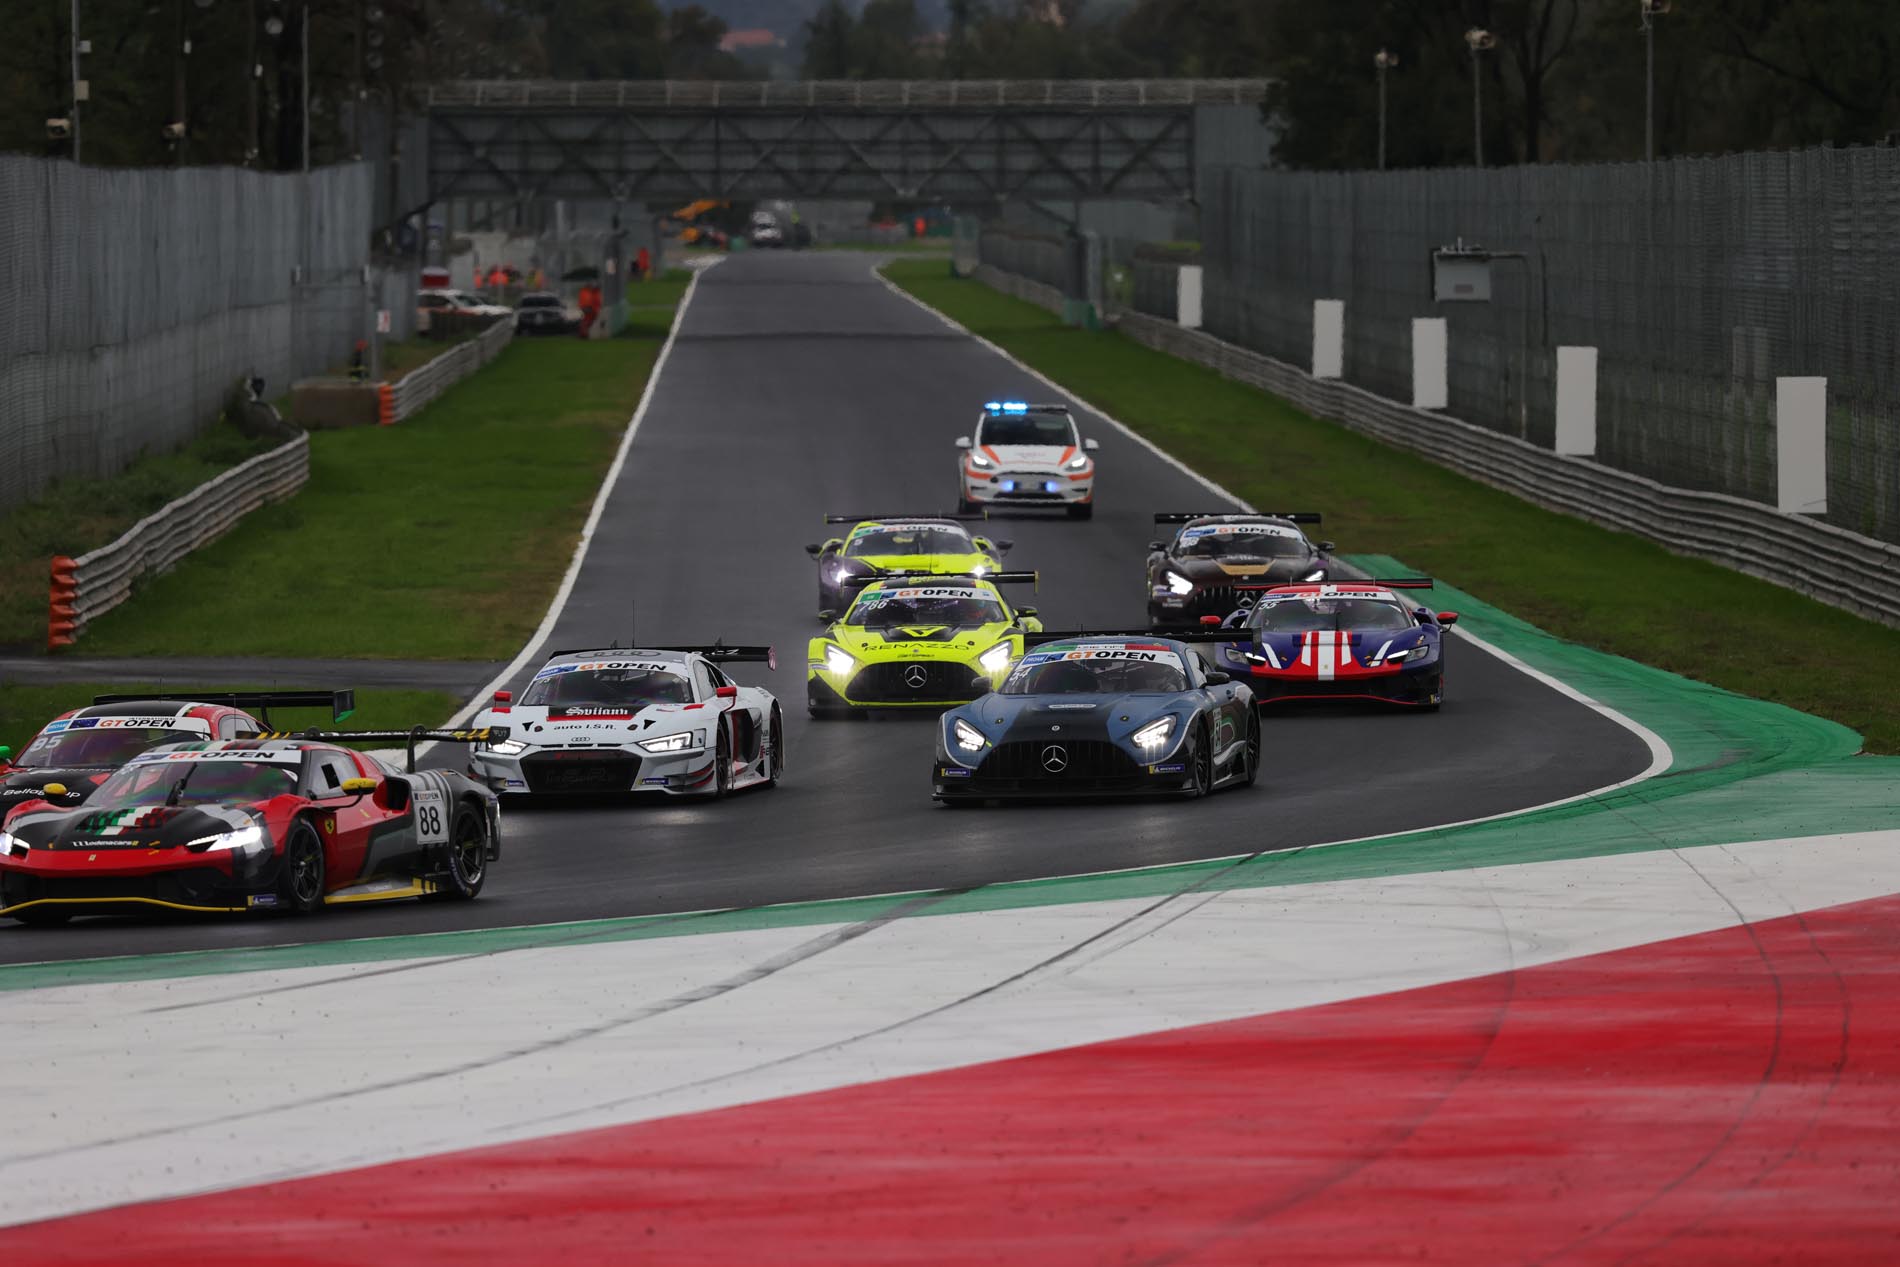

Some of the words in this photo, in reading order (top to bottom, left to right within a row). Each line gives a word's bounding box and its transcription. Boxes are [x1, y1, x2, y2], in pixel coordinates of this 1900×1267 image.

[898, 589, 973, 598] GTOPEN
[860, 600, 889, 611] 786
[1067, 651, 1156, 661] GTOPEN
[579, 663, 667, 671] GTOPEN
[99, 719, 176, 728] GTOPEN
[419, 806, 440, 835] 88
